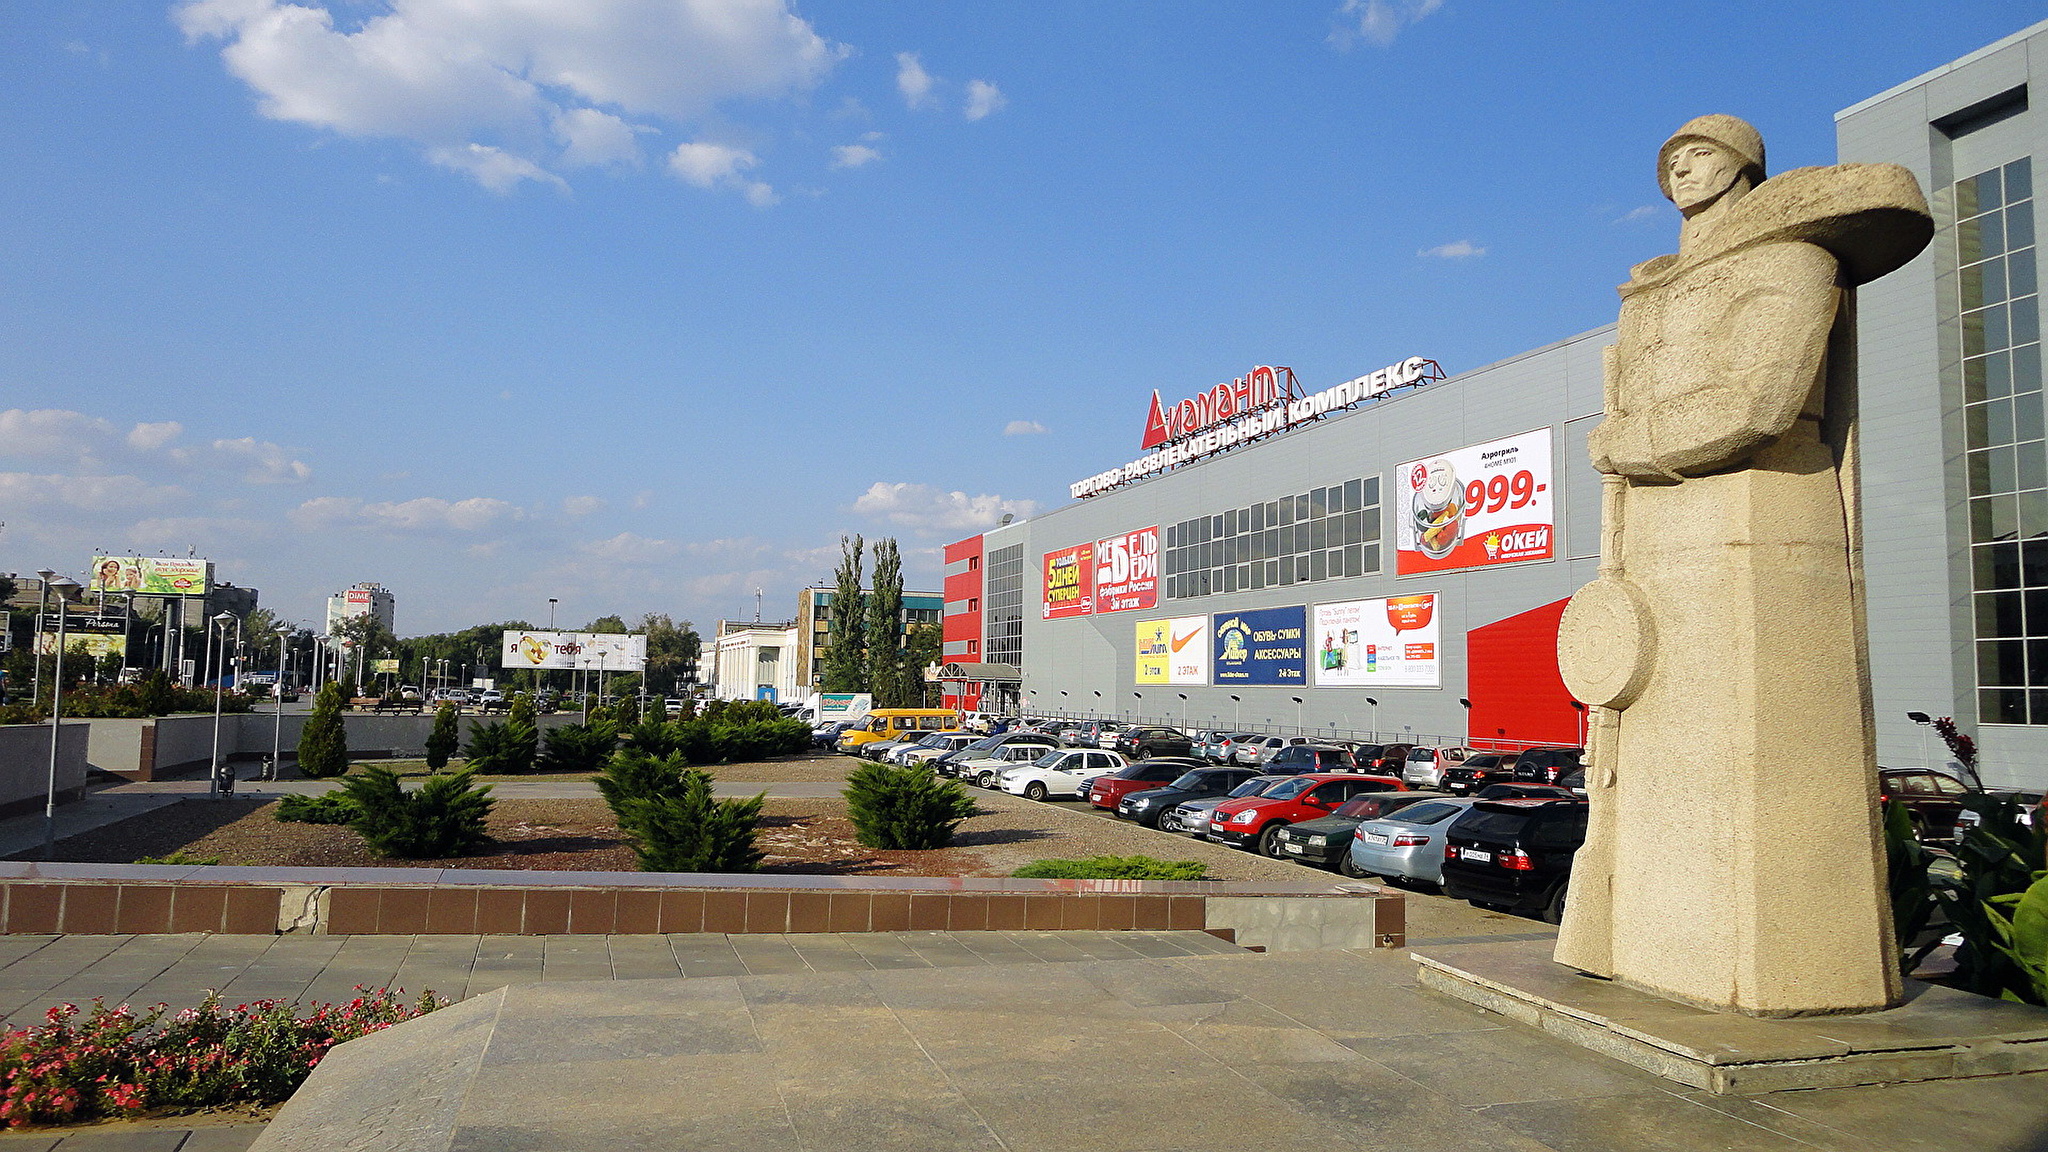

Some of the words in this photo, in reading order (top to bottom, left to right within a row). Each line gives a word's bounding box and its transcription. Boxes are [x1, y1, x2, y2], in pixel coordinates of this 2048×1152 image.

[1141, 365, 1280, 450] Диамант
[1070, 399, 1284, 499] ТОРГОВО-РАЗВЛЕКАТЕЛЬНЫЙ
[1288, 356, 1424, 425] КОМПЛЕКС
[1481, 447, 1519, 460] Аэрогриль
[1047, 559, 1057, 589] 5
[1055, 564, 1080, 587] ДНЕЙ
[1129, 580, 1154, 592] России
[349, 592, 369, 600] DIME
[85, 618, 120, 628] Persona
[554, 642, 581, 655] тебя
[1254, 648, 1302, 660] АКСЕССУАРЫ
[1177, 666, 1182, 676] 2
[1182, 665, 1199, 676] ЭТАЖ
